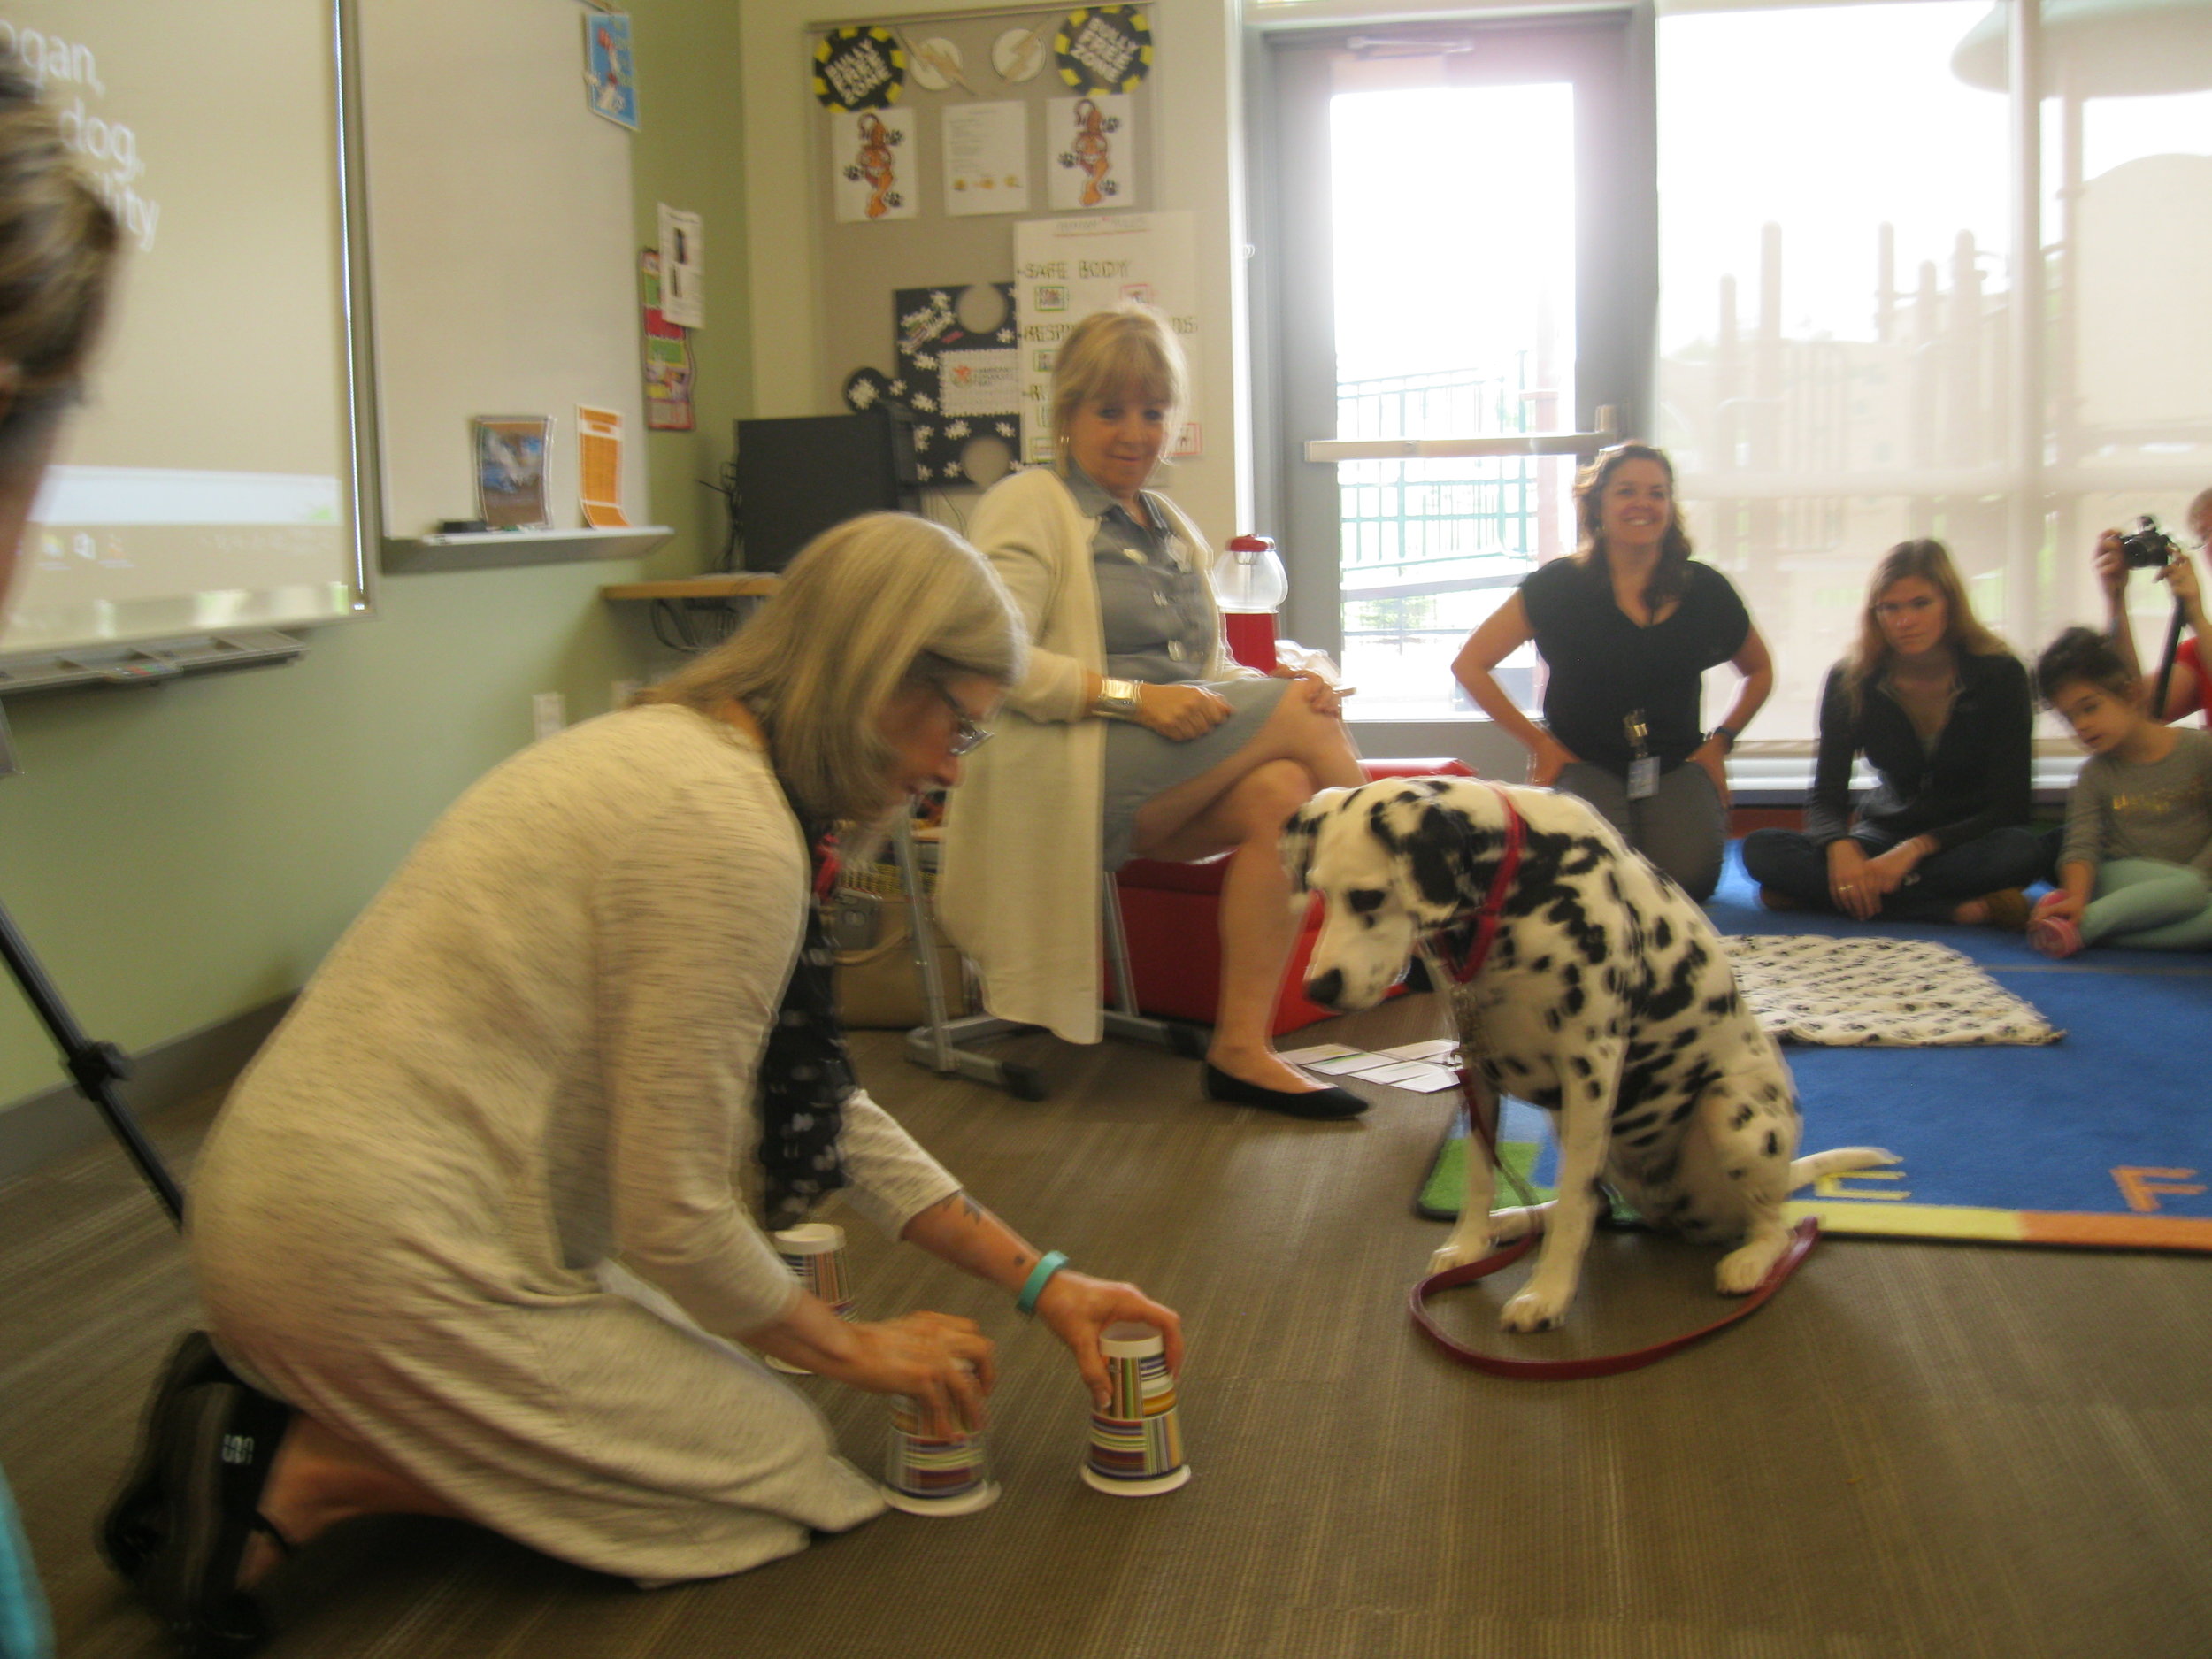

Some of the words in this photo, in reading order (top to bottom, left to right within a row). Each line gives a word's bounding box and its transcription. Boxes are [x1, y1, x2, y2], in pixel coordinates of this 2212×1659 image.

[1025, 260, 1068, 279] SAFE
[1079, 258, 1132, 279] BODY
[2108, 1164, 2208, 1213] F
